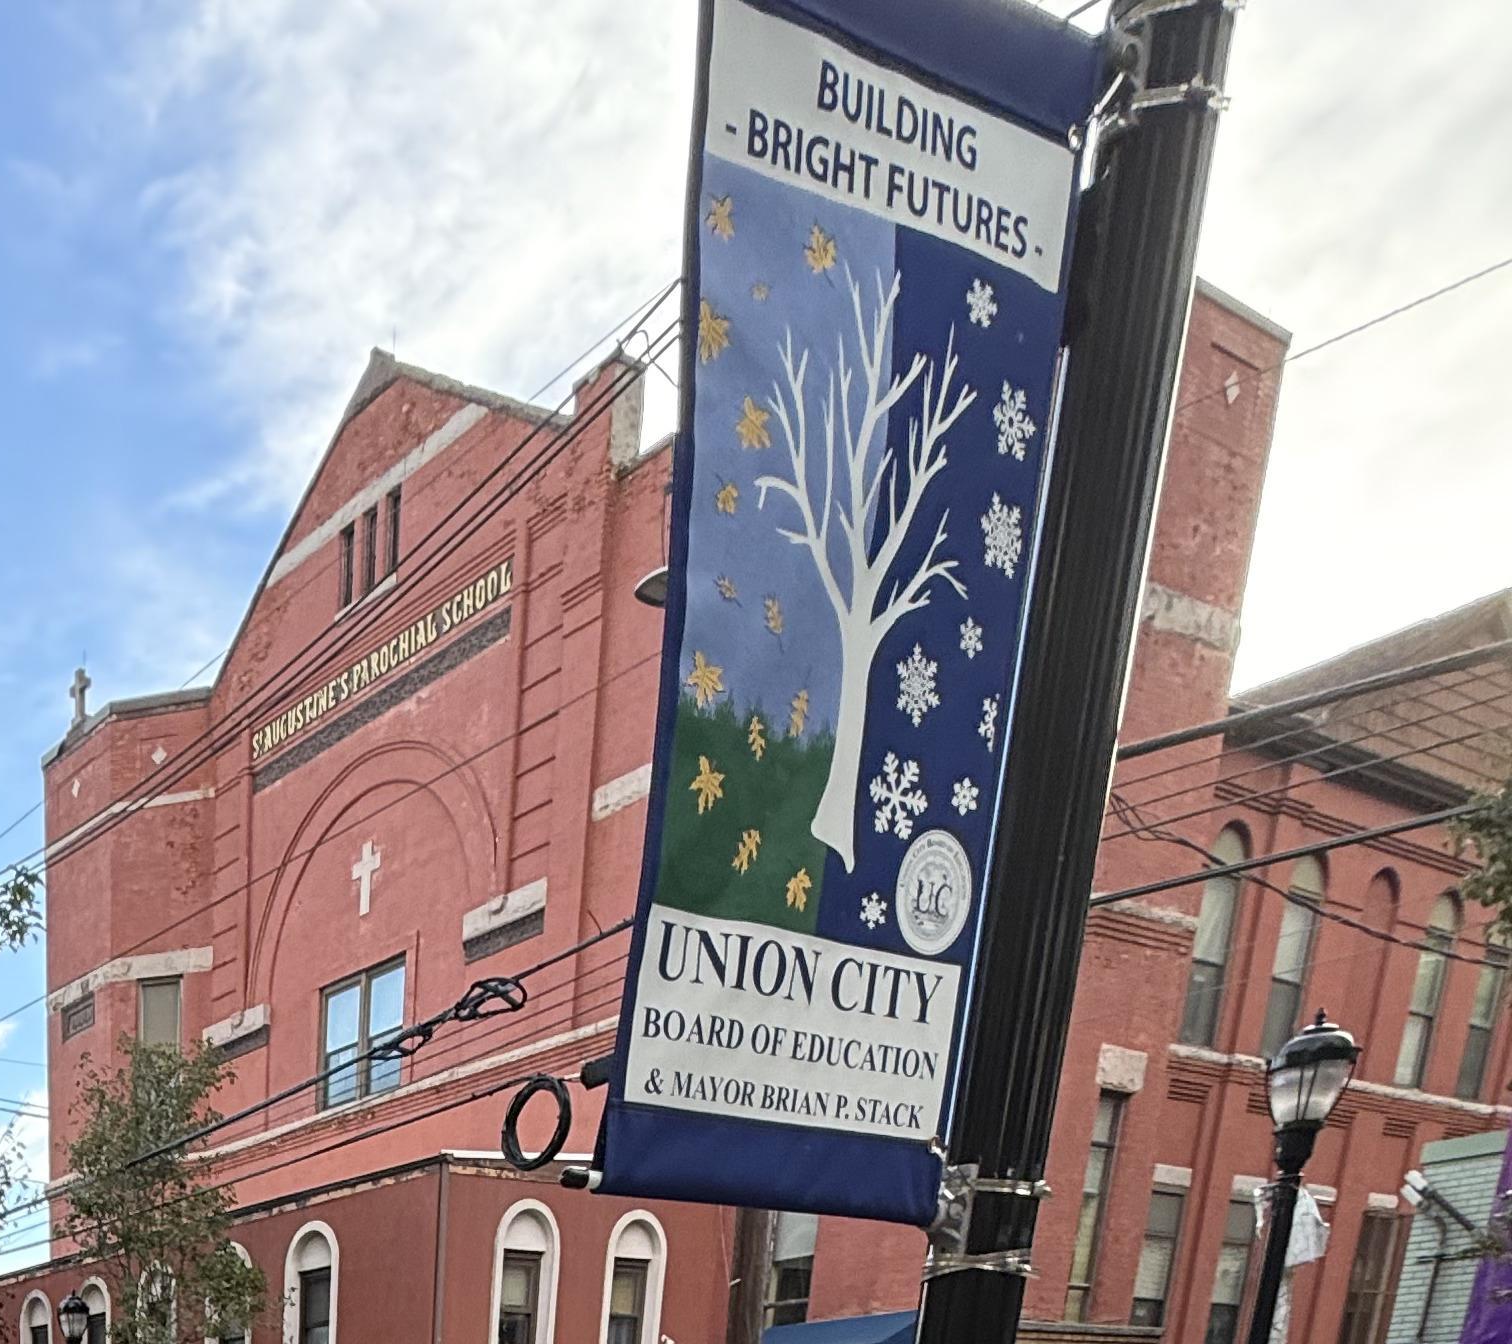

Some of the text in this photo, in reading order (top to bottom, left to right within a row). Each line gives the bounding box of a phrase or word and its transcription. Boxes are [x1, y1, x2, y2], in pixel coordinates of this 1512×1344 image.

[817, 59, 978, 172] BUILDING
[746, 108, 880, 200] BRIGHT
[887, 165, 1030, 260] FUTURES
[351, 611, 438, 693] PAROCHIAL
[441, 560, 514, 634] SCHOOL
[657, 920, 944, 1025] UNION CITY
[641, 1006, 940, 1081] BOARD OF EDUCATION
[643, 1067, 926, 1130] & MAYOR BRIAN P. STACK
